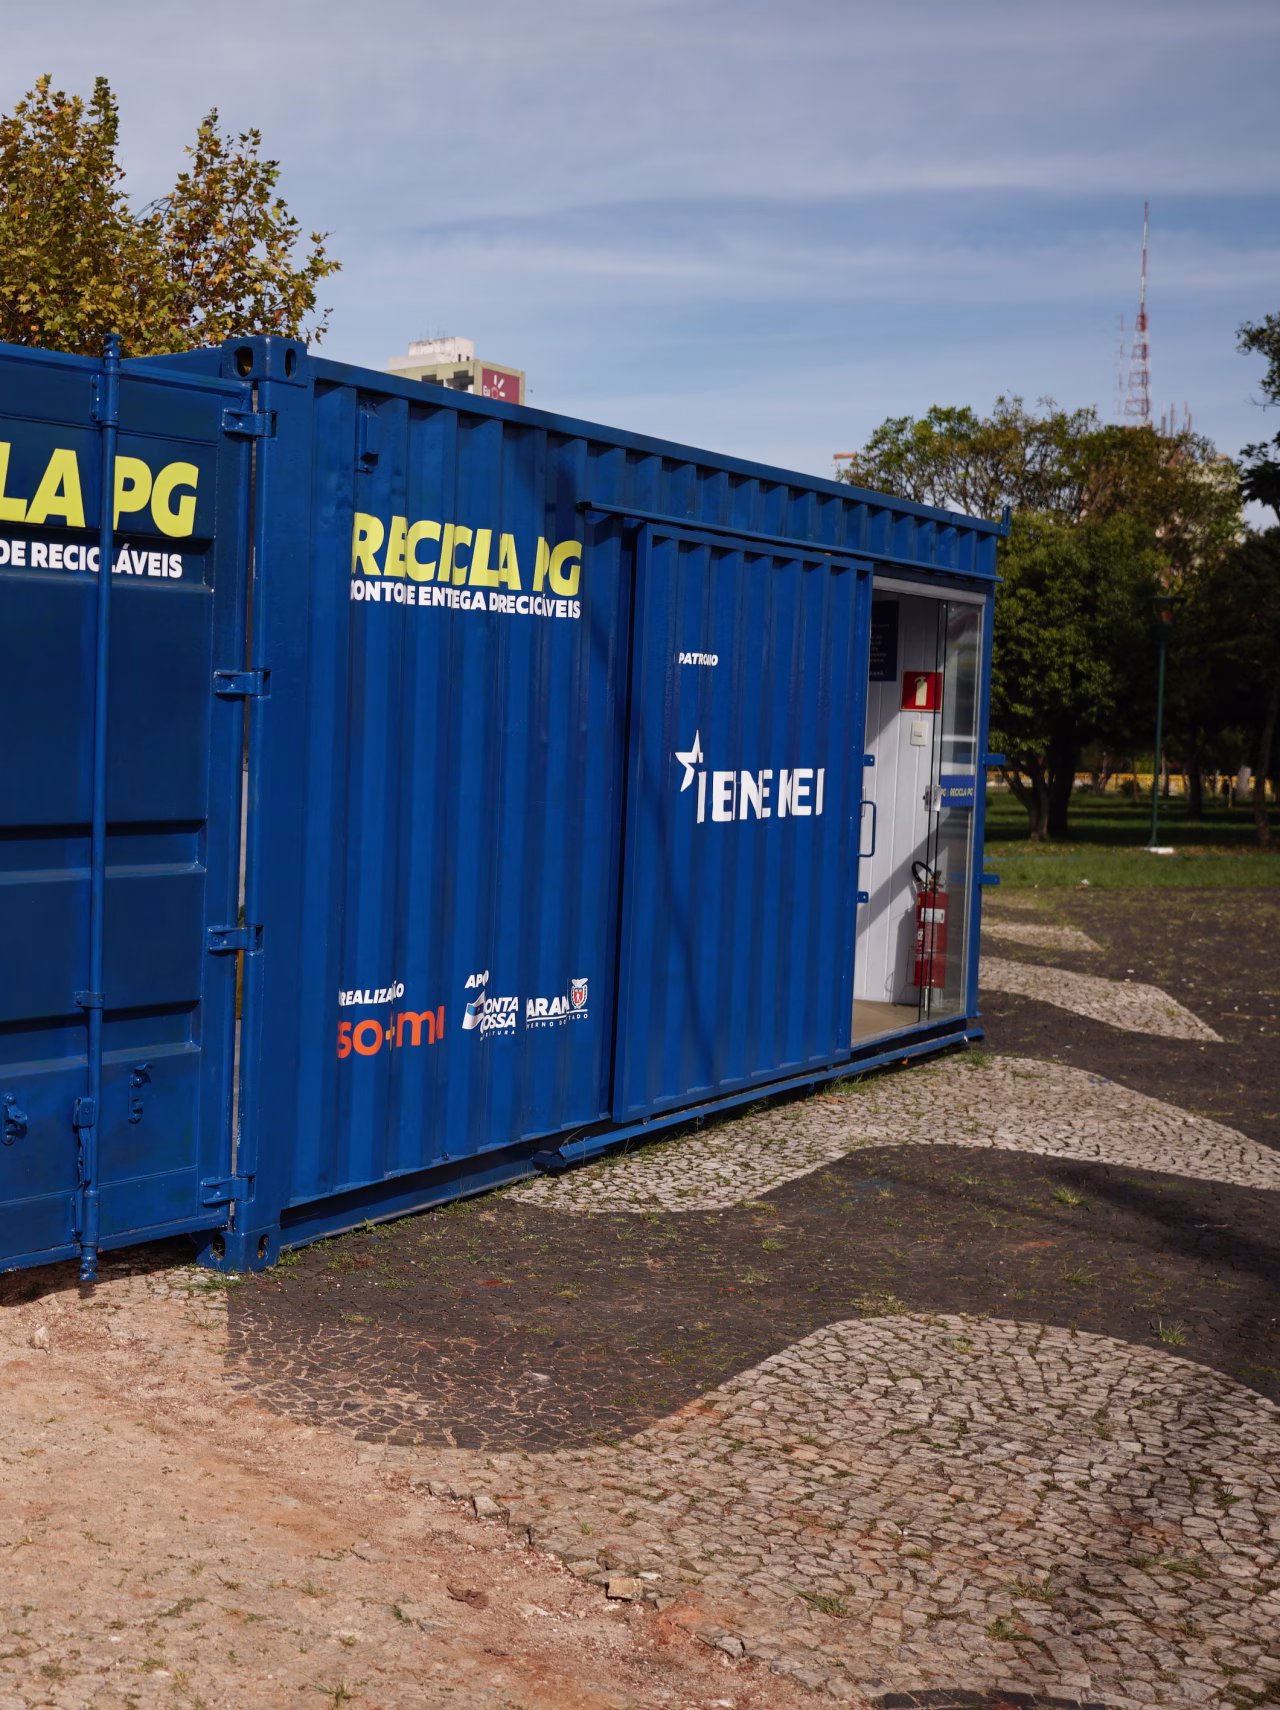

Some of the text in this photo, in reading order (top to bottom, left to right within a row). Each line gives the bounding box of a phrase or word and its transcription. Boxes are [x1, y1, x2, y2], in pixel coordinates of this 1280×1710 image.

[112, 455, 199, 538] PG
[532, 536, 582, 597] PG
[483, 997, 519, 1014] ONTA
